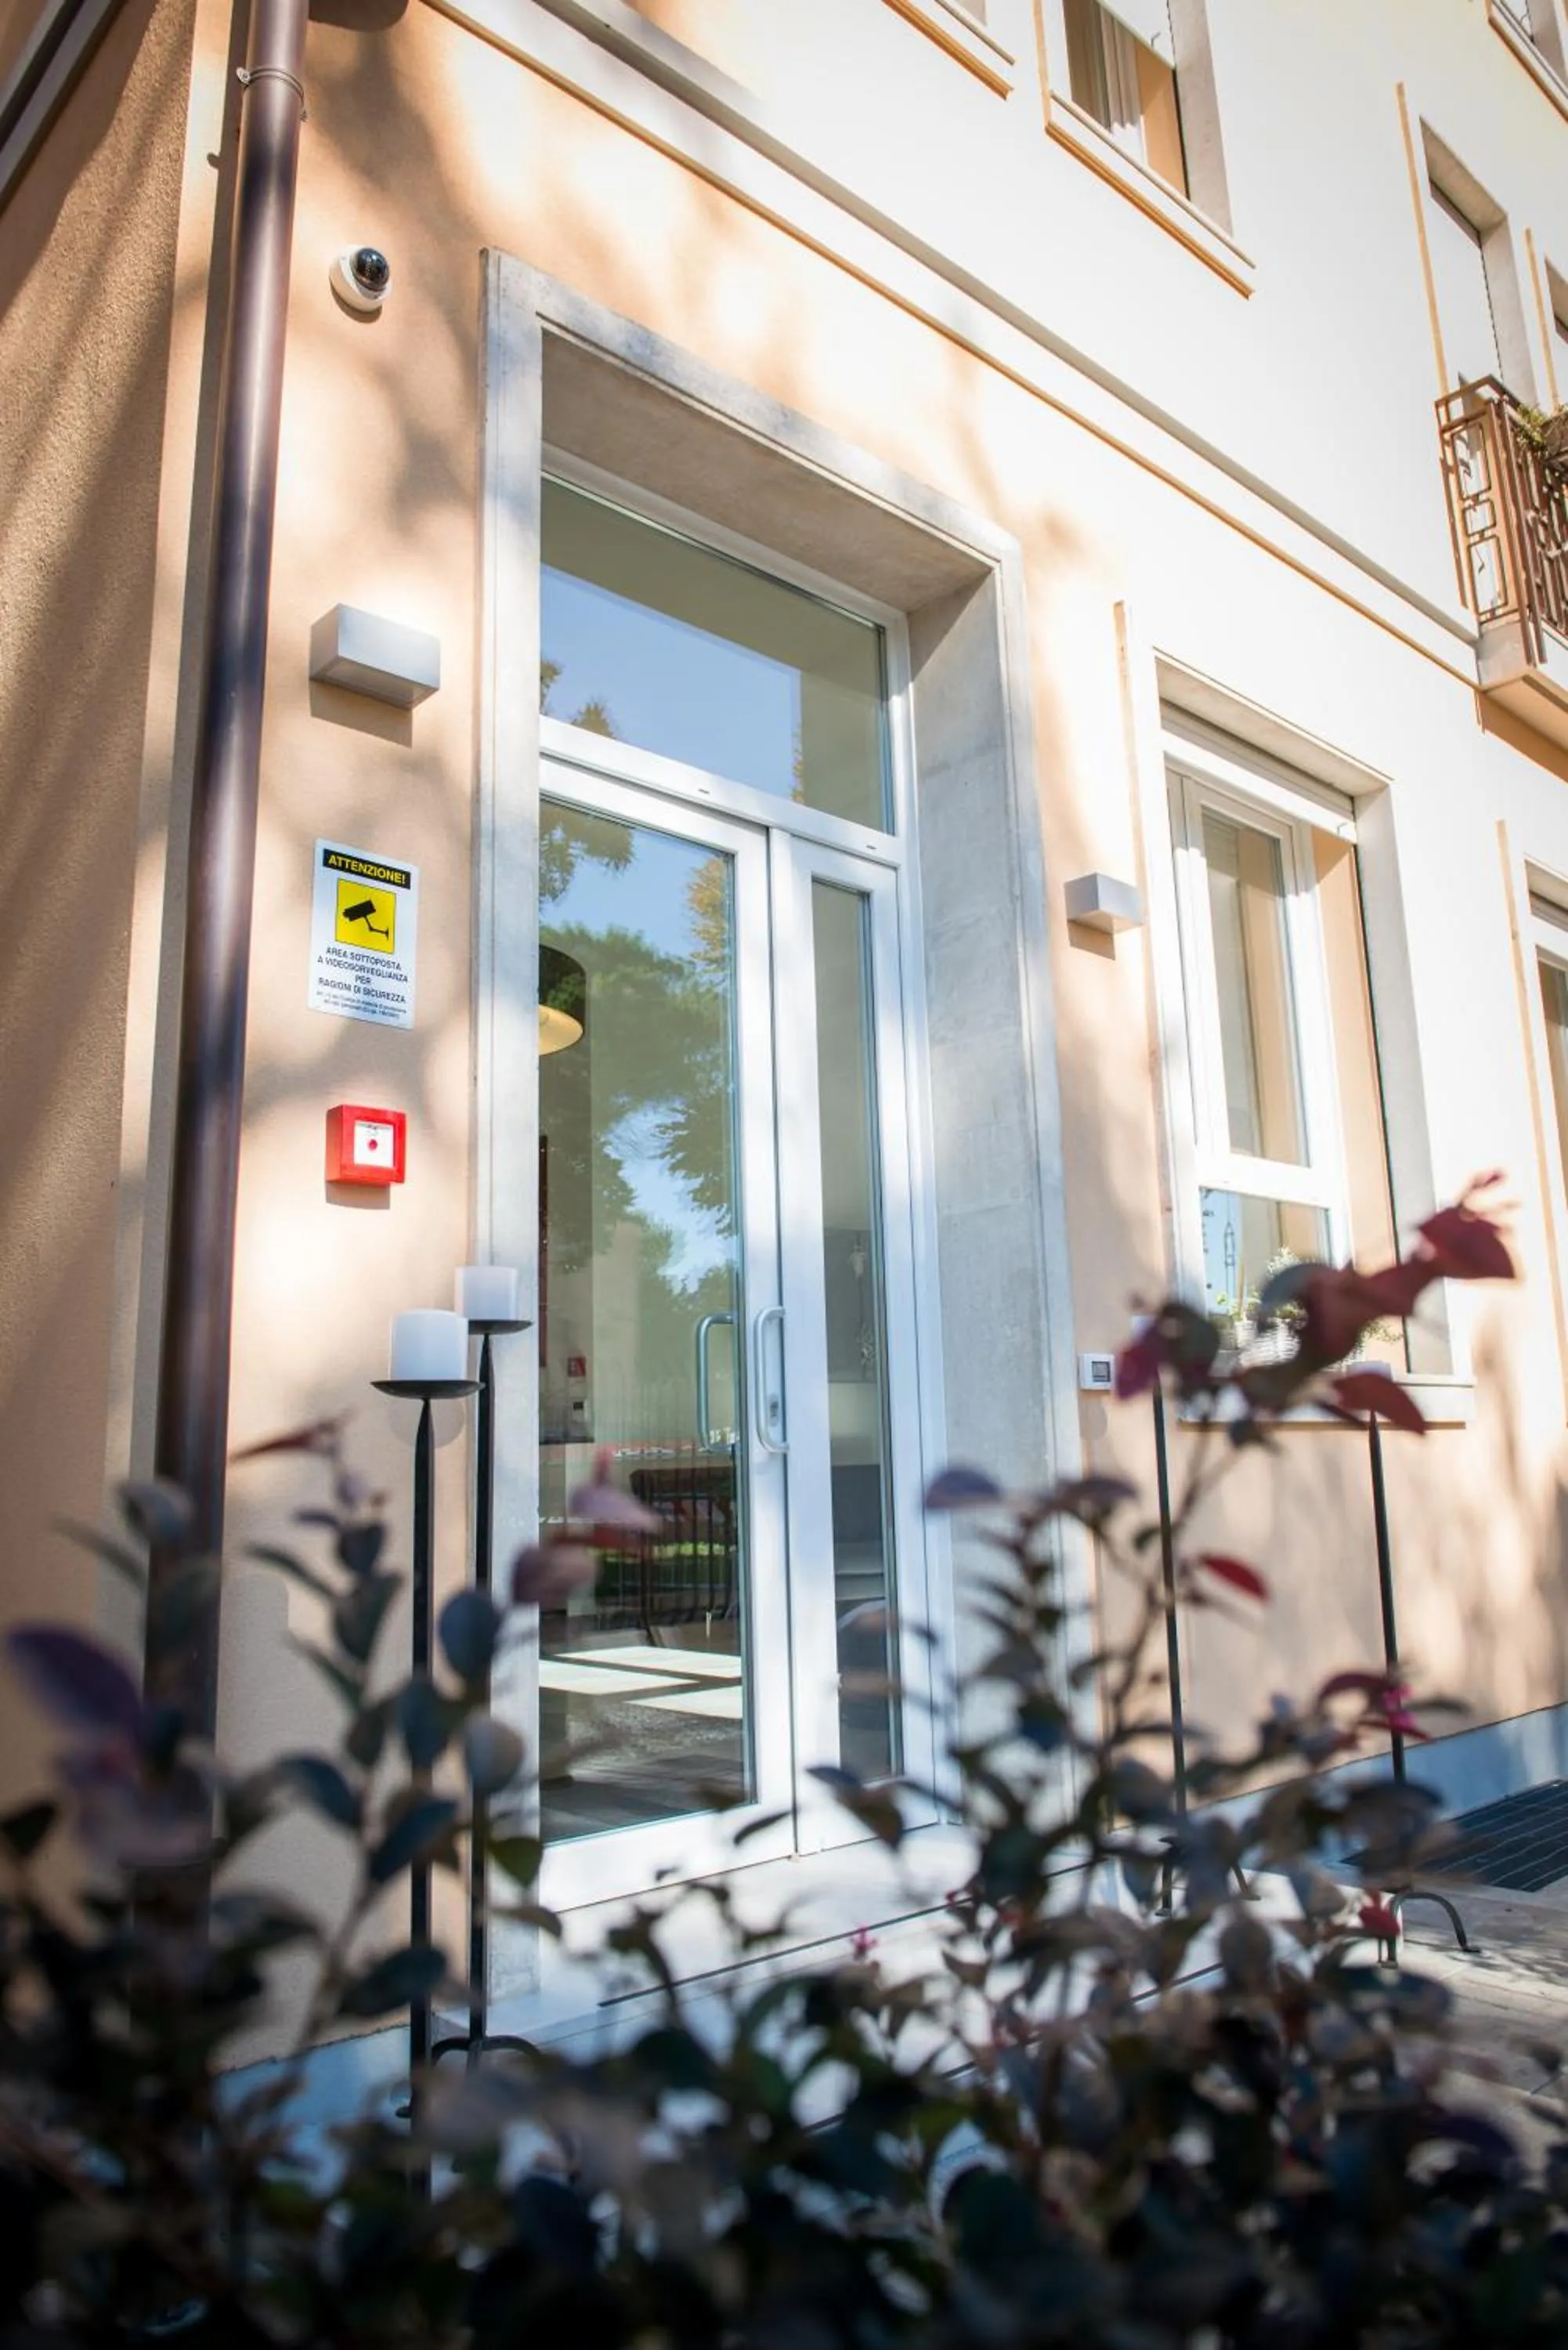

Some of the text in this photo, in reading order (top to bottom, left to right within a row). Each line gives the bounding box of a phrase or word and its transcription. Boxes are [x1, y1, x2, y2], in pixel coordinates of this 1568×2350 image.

[328, 855, 406, 884] ATTENZIONE!
[326, 947, 401, 971] AREA SOTTOPOSTA
[319, 978, 352, 991] RAGIONI
[353, 985, 361, 994] DI
[363, 987, 406, 1003] SICUREZZA
[355, 974, 372, 985] PER
